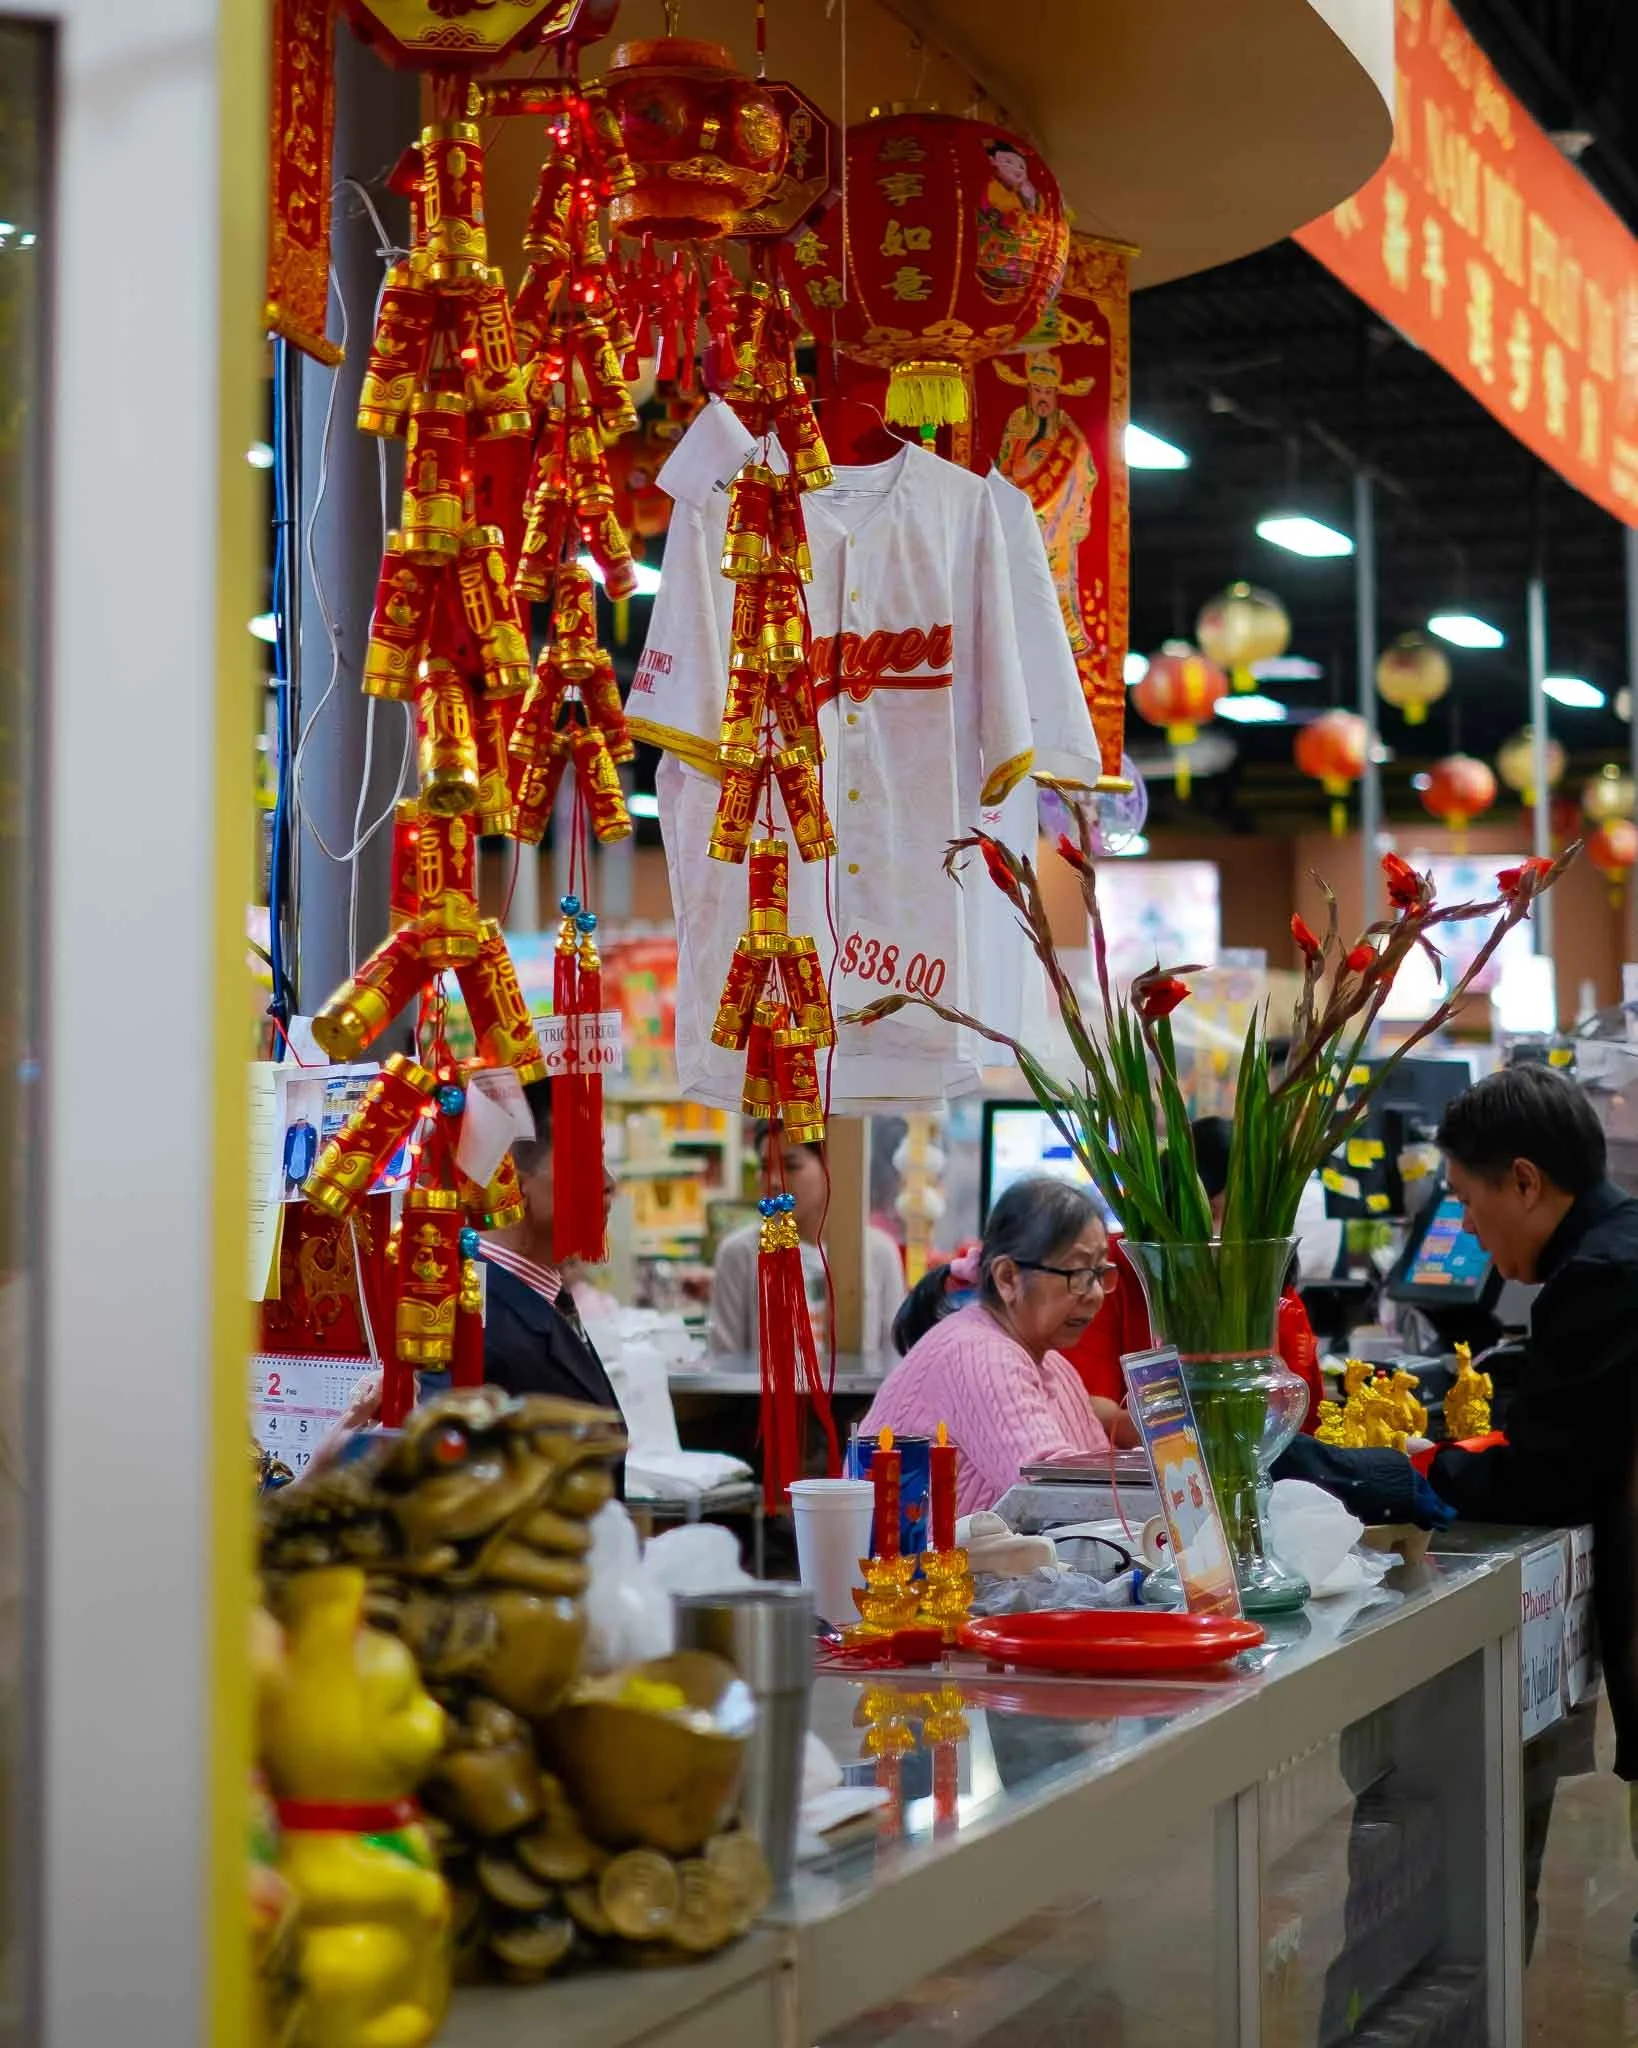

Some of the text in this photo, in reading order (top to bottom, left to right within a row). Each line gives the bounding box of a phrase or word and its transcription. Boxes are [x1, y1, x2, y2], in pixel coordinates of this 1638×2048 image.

[840, 929, 946, 998] $38.00
[268, 1372, 281, 1396] 2
[269, 1417, 308, 1432] 4 5
[295, 1453, 310, 1465] 12
